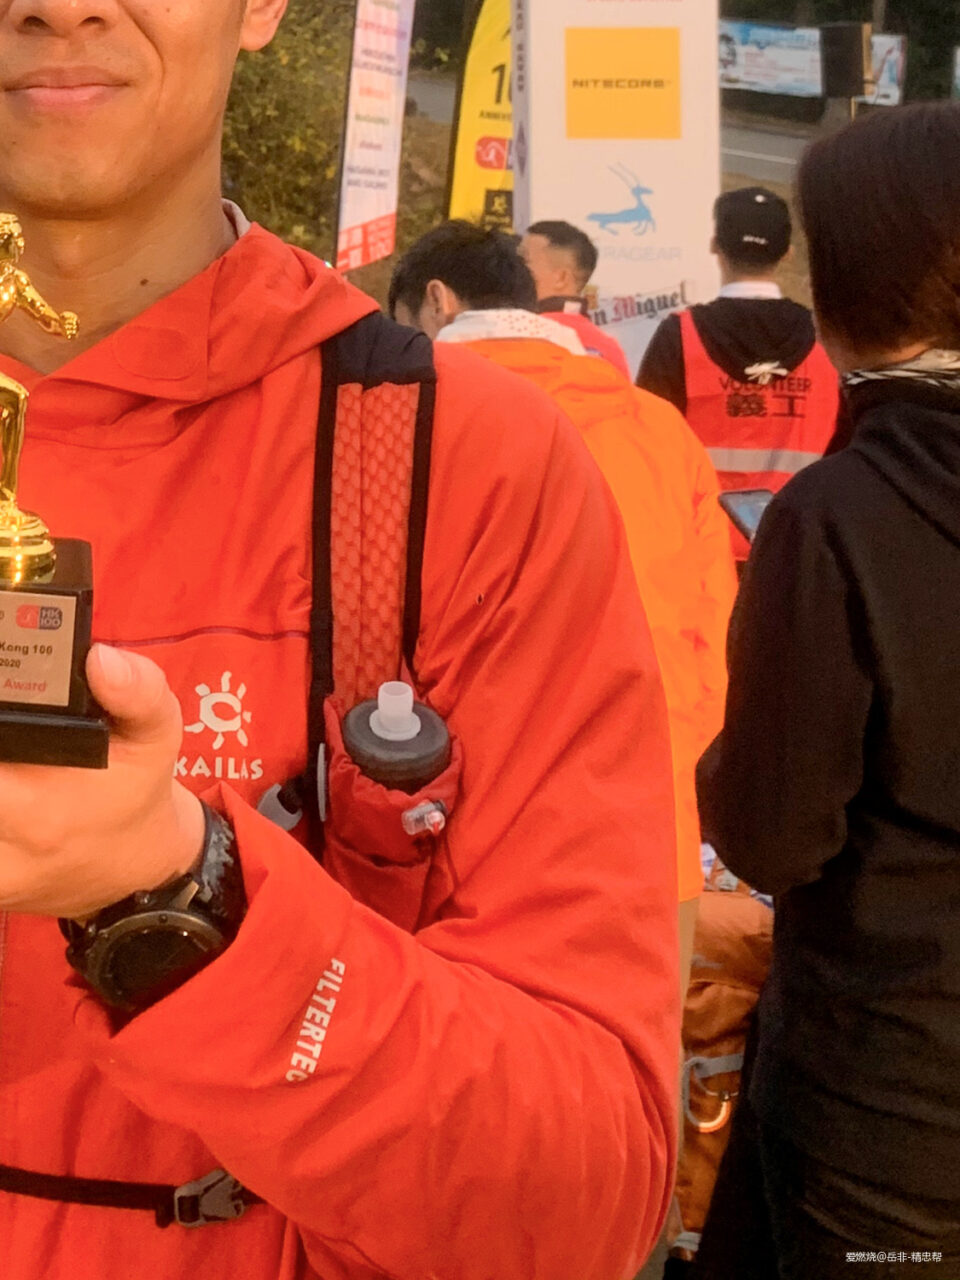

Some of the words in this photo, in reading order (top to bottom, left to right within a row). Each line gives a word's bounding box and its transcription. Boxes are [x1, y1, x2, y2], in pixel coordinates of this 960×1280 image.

[611, 279, 690, 323] Miguel
[41, 608, 61, 618] HK
[32, 643, 53, 655] 100
[3, 678, 47, 693] Award
[172, 756, 264, 780] KAILAS
